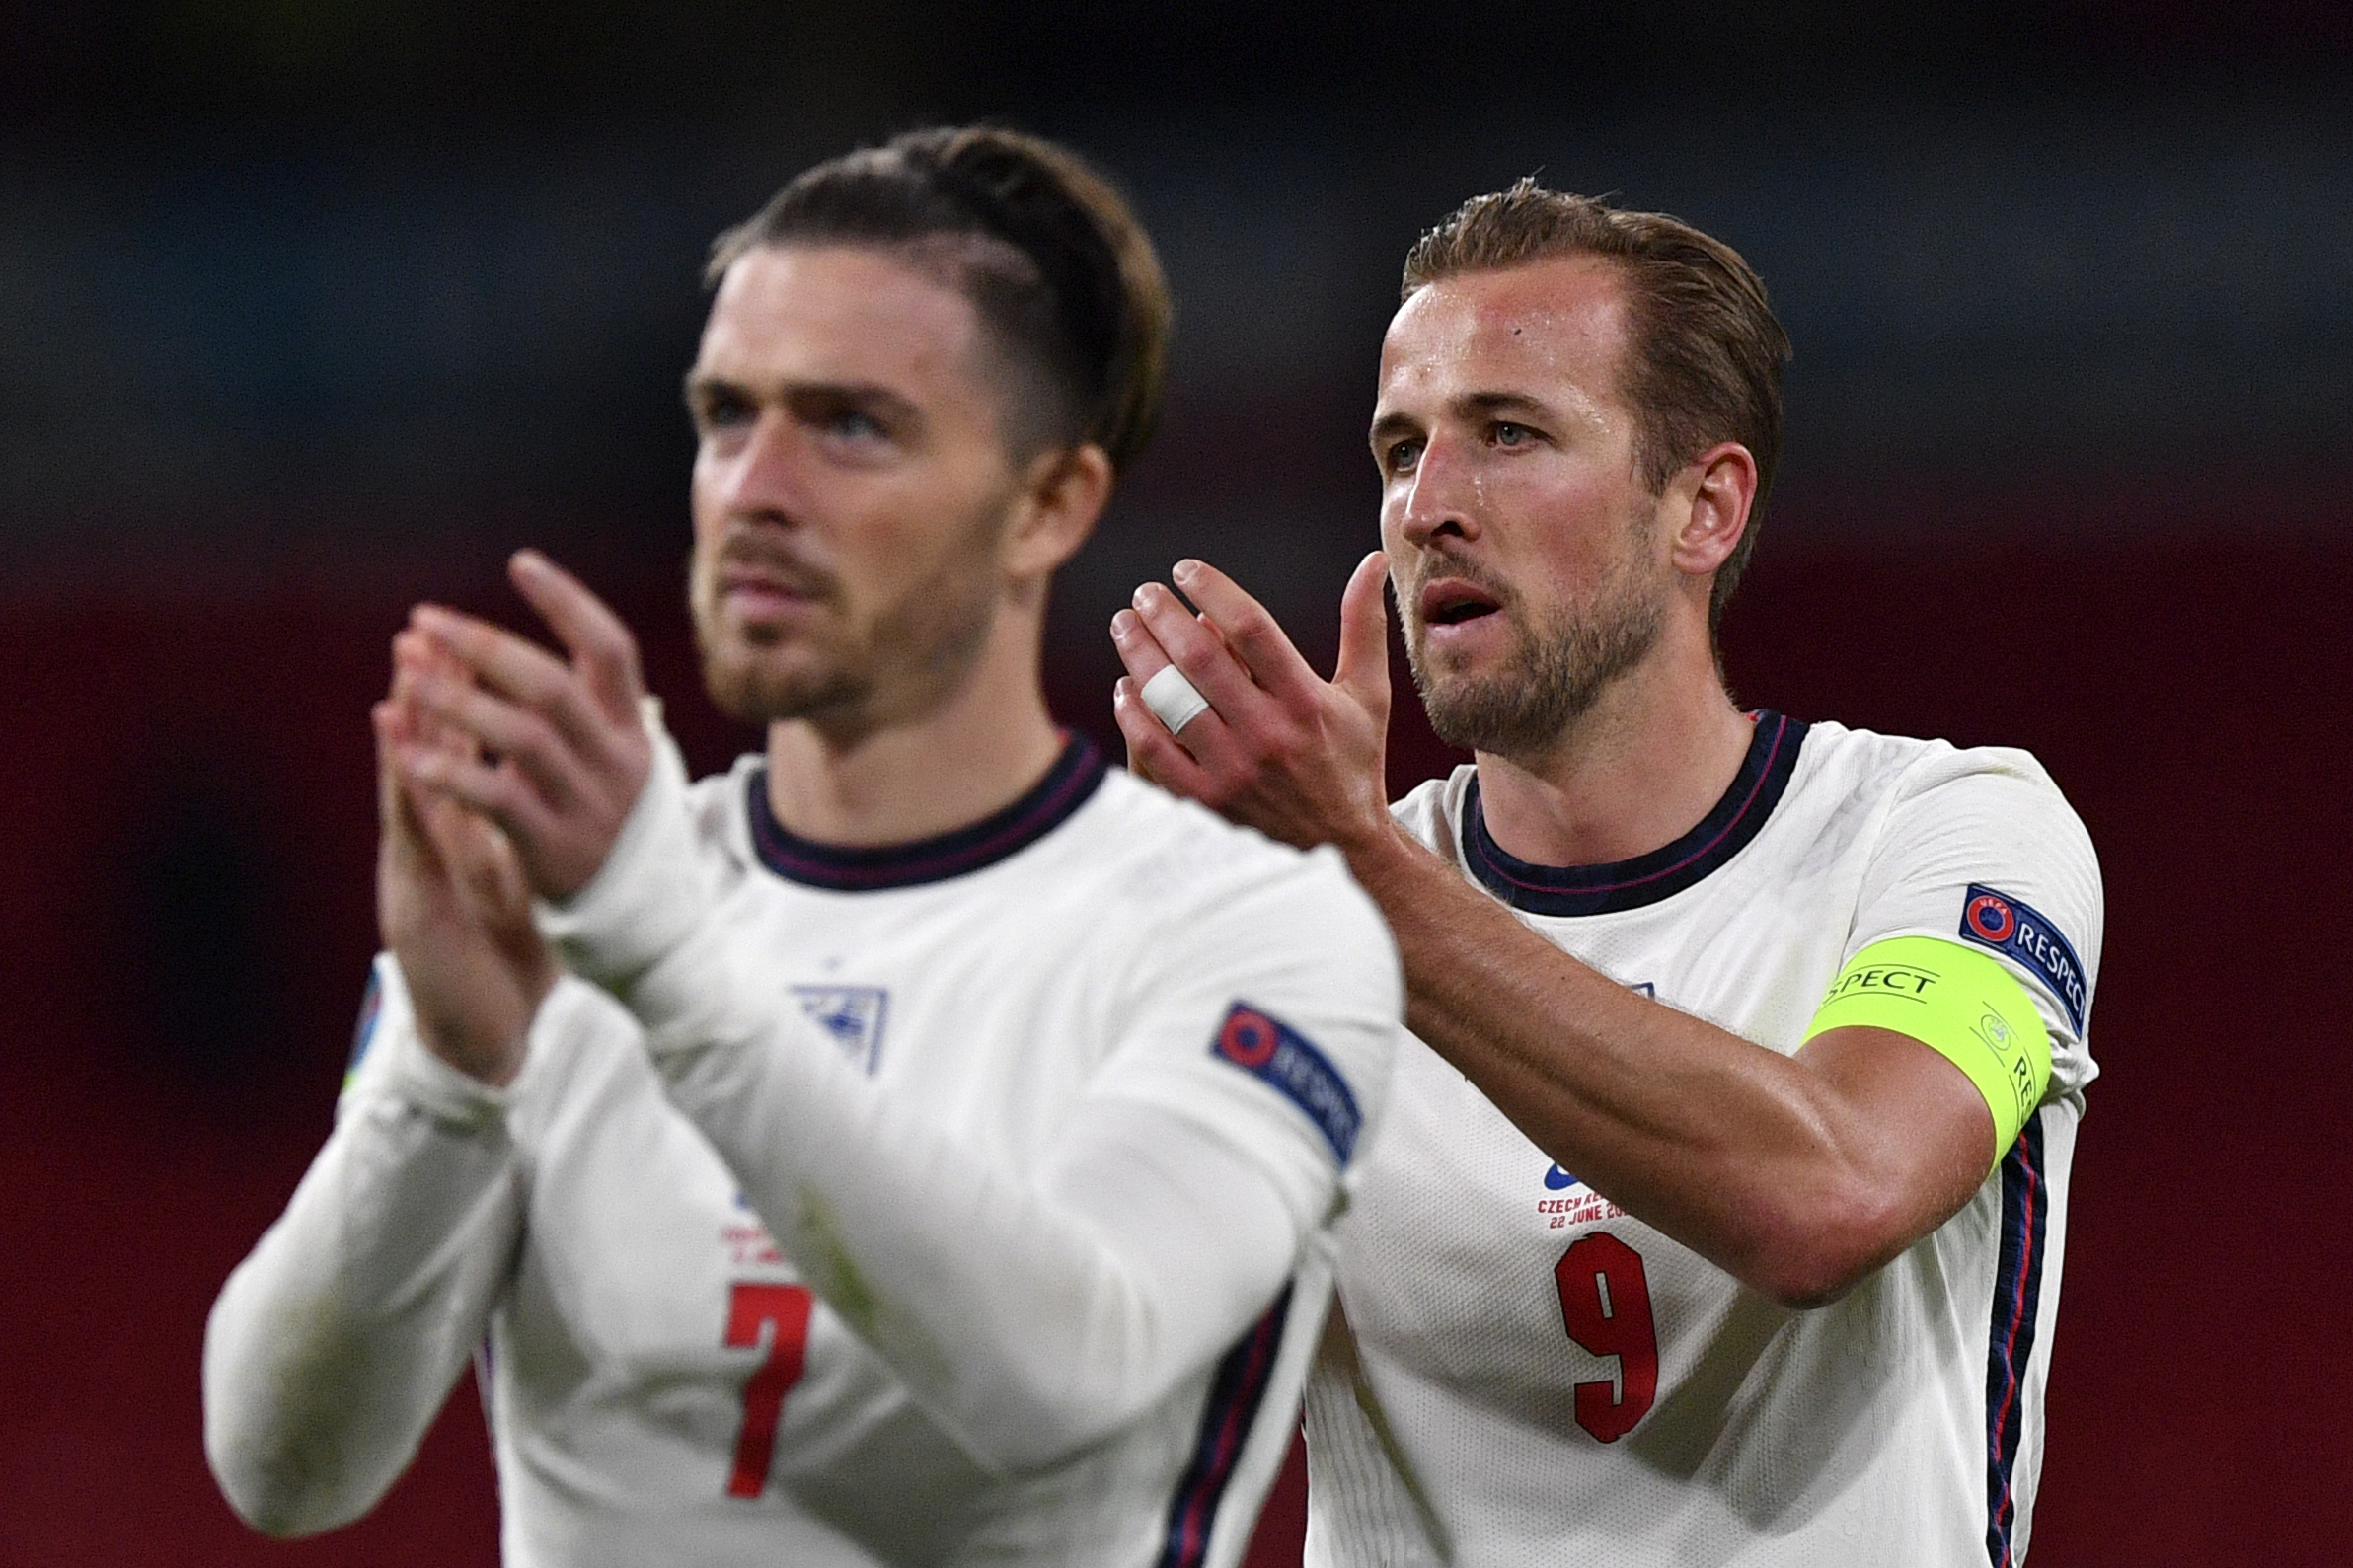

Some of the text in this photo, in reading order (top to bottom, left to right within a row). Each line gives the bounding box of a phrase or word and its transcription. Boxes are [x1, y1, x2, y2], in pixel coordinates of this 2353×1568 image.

[1537, 1196, 1582, 1214] CZECH
[1549, 1202, 1628, 1230] 22 JUNE 20
[723, 1281, 814, 1499] 7
[1554, 1232, 1659, 1444] 9
